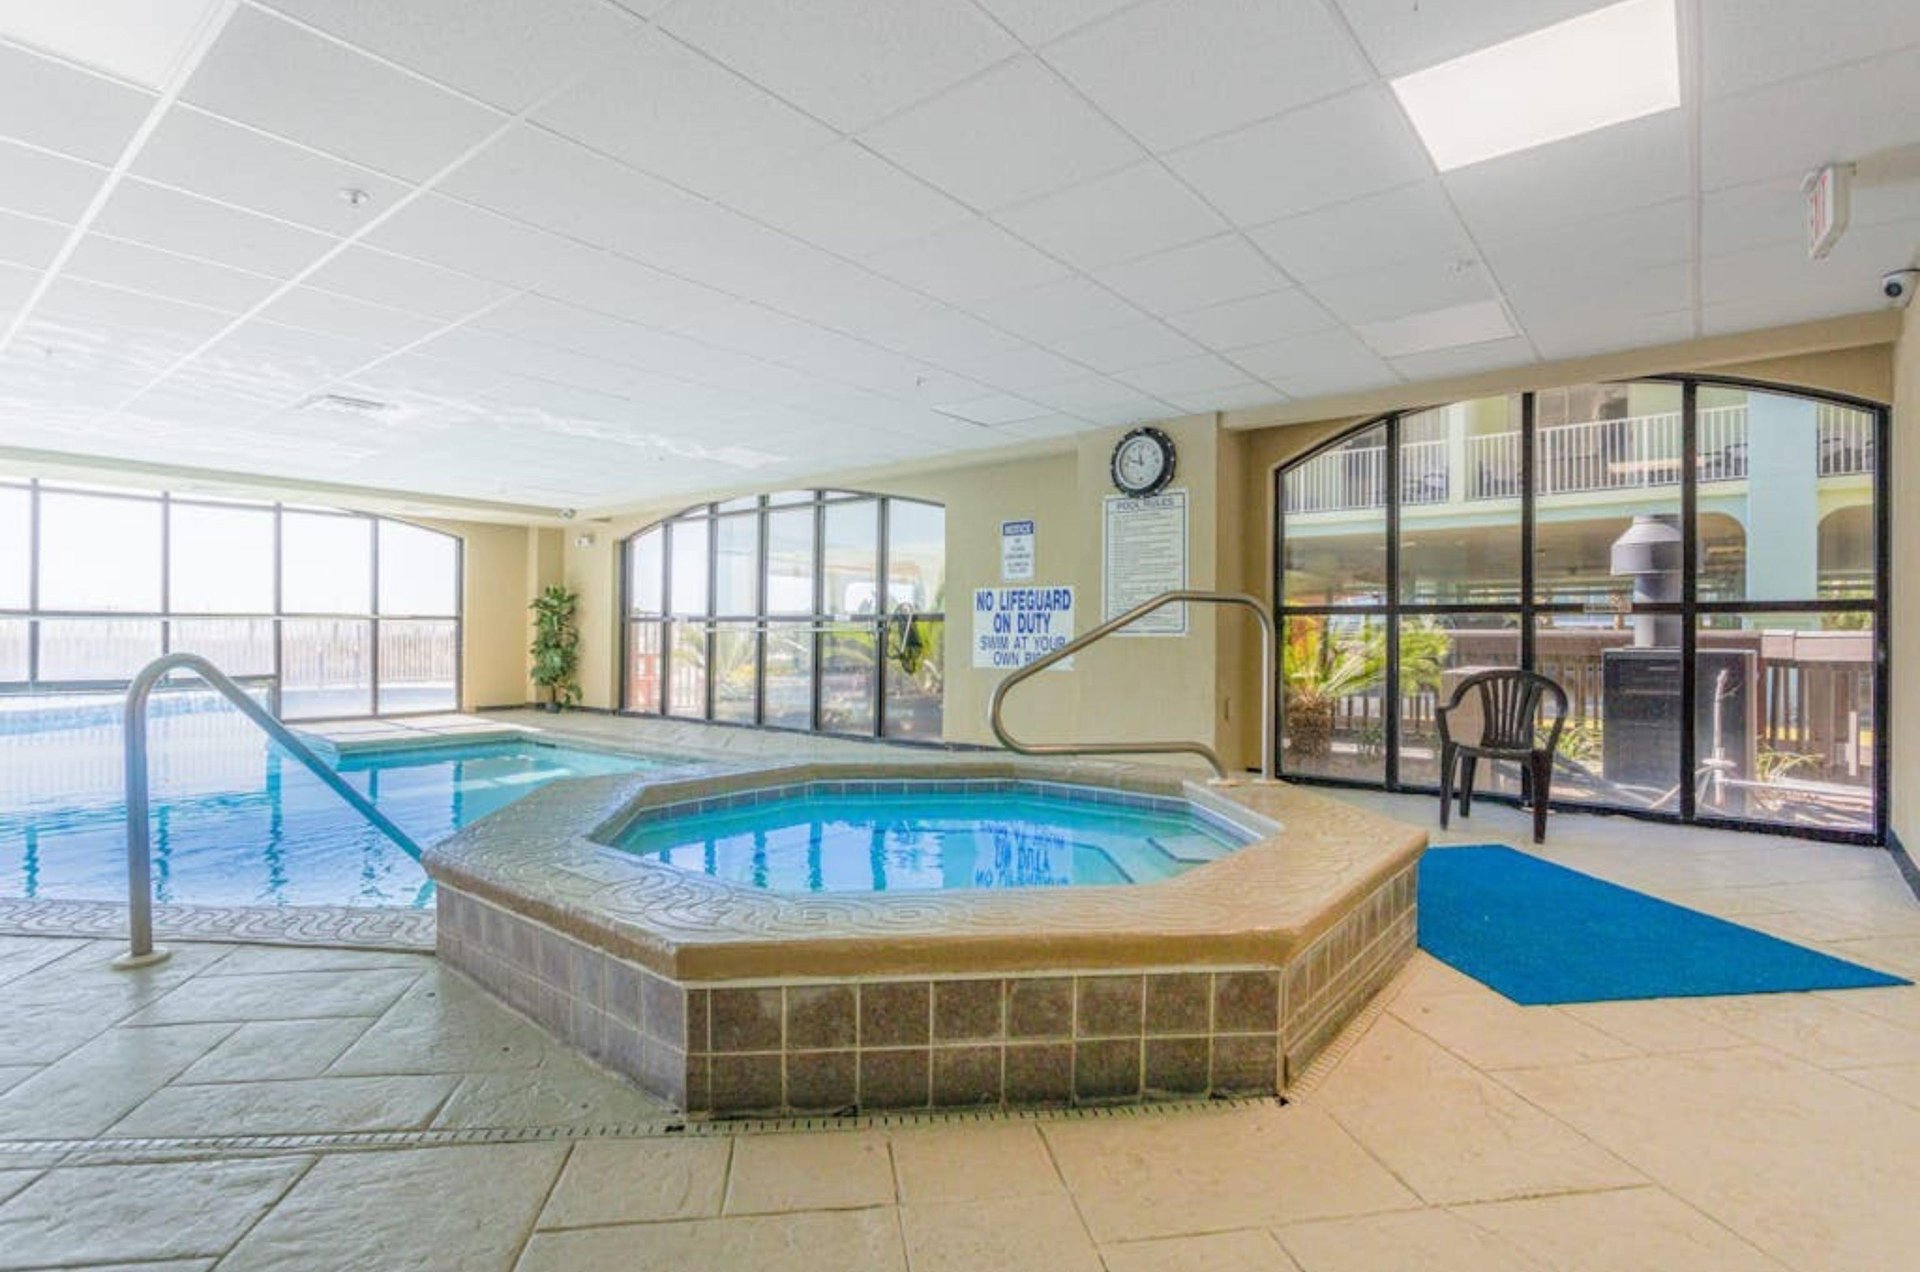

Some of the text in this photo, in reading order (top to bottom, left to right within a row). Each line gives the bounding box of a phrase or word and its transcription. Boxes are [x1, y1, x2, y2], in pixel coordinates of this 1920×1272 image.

[976, 589, 1072, 611] NO LIFEGUARD
[993, 612, 1051, 633] ON DUTY
[980, 635, 1066, 651] SWIM AT YOUR
[993, 651, 1019, 666] OWN
